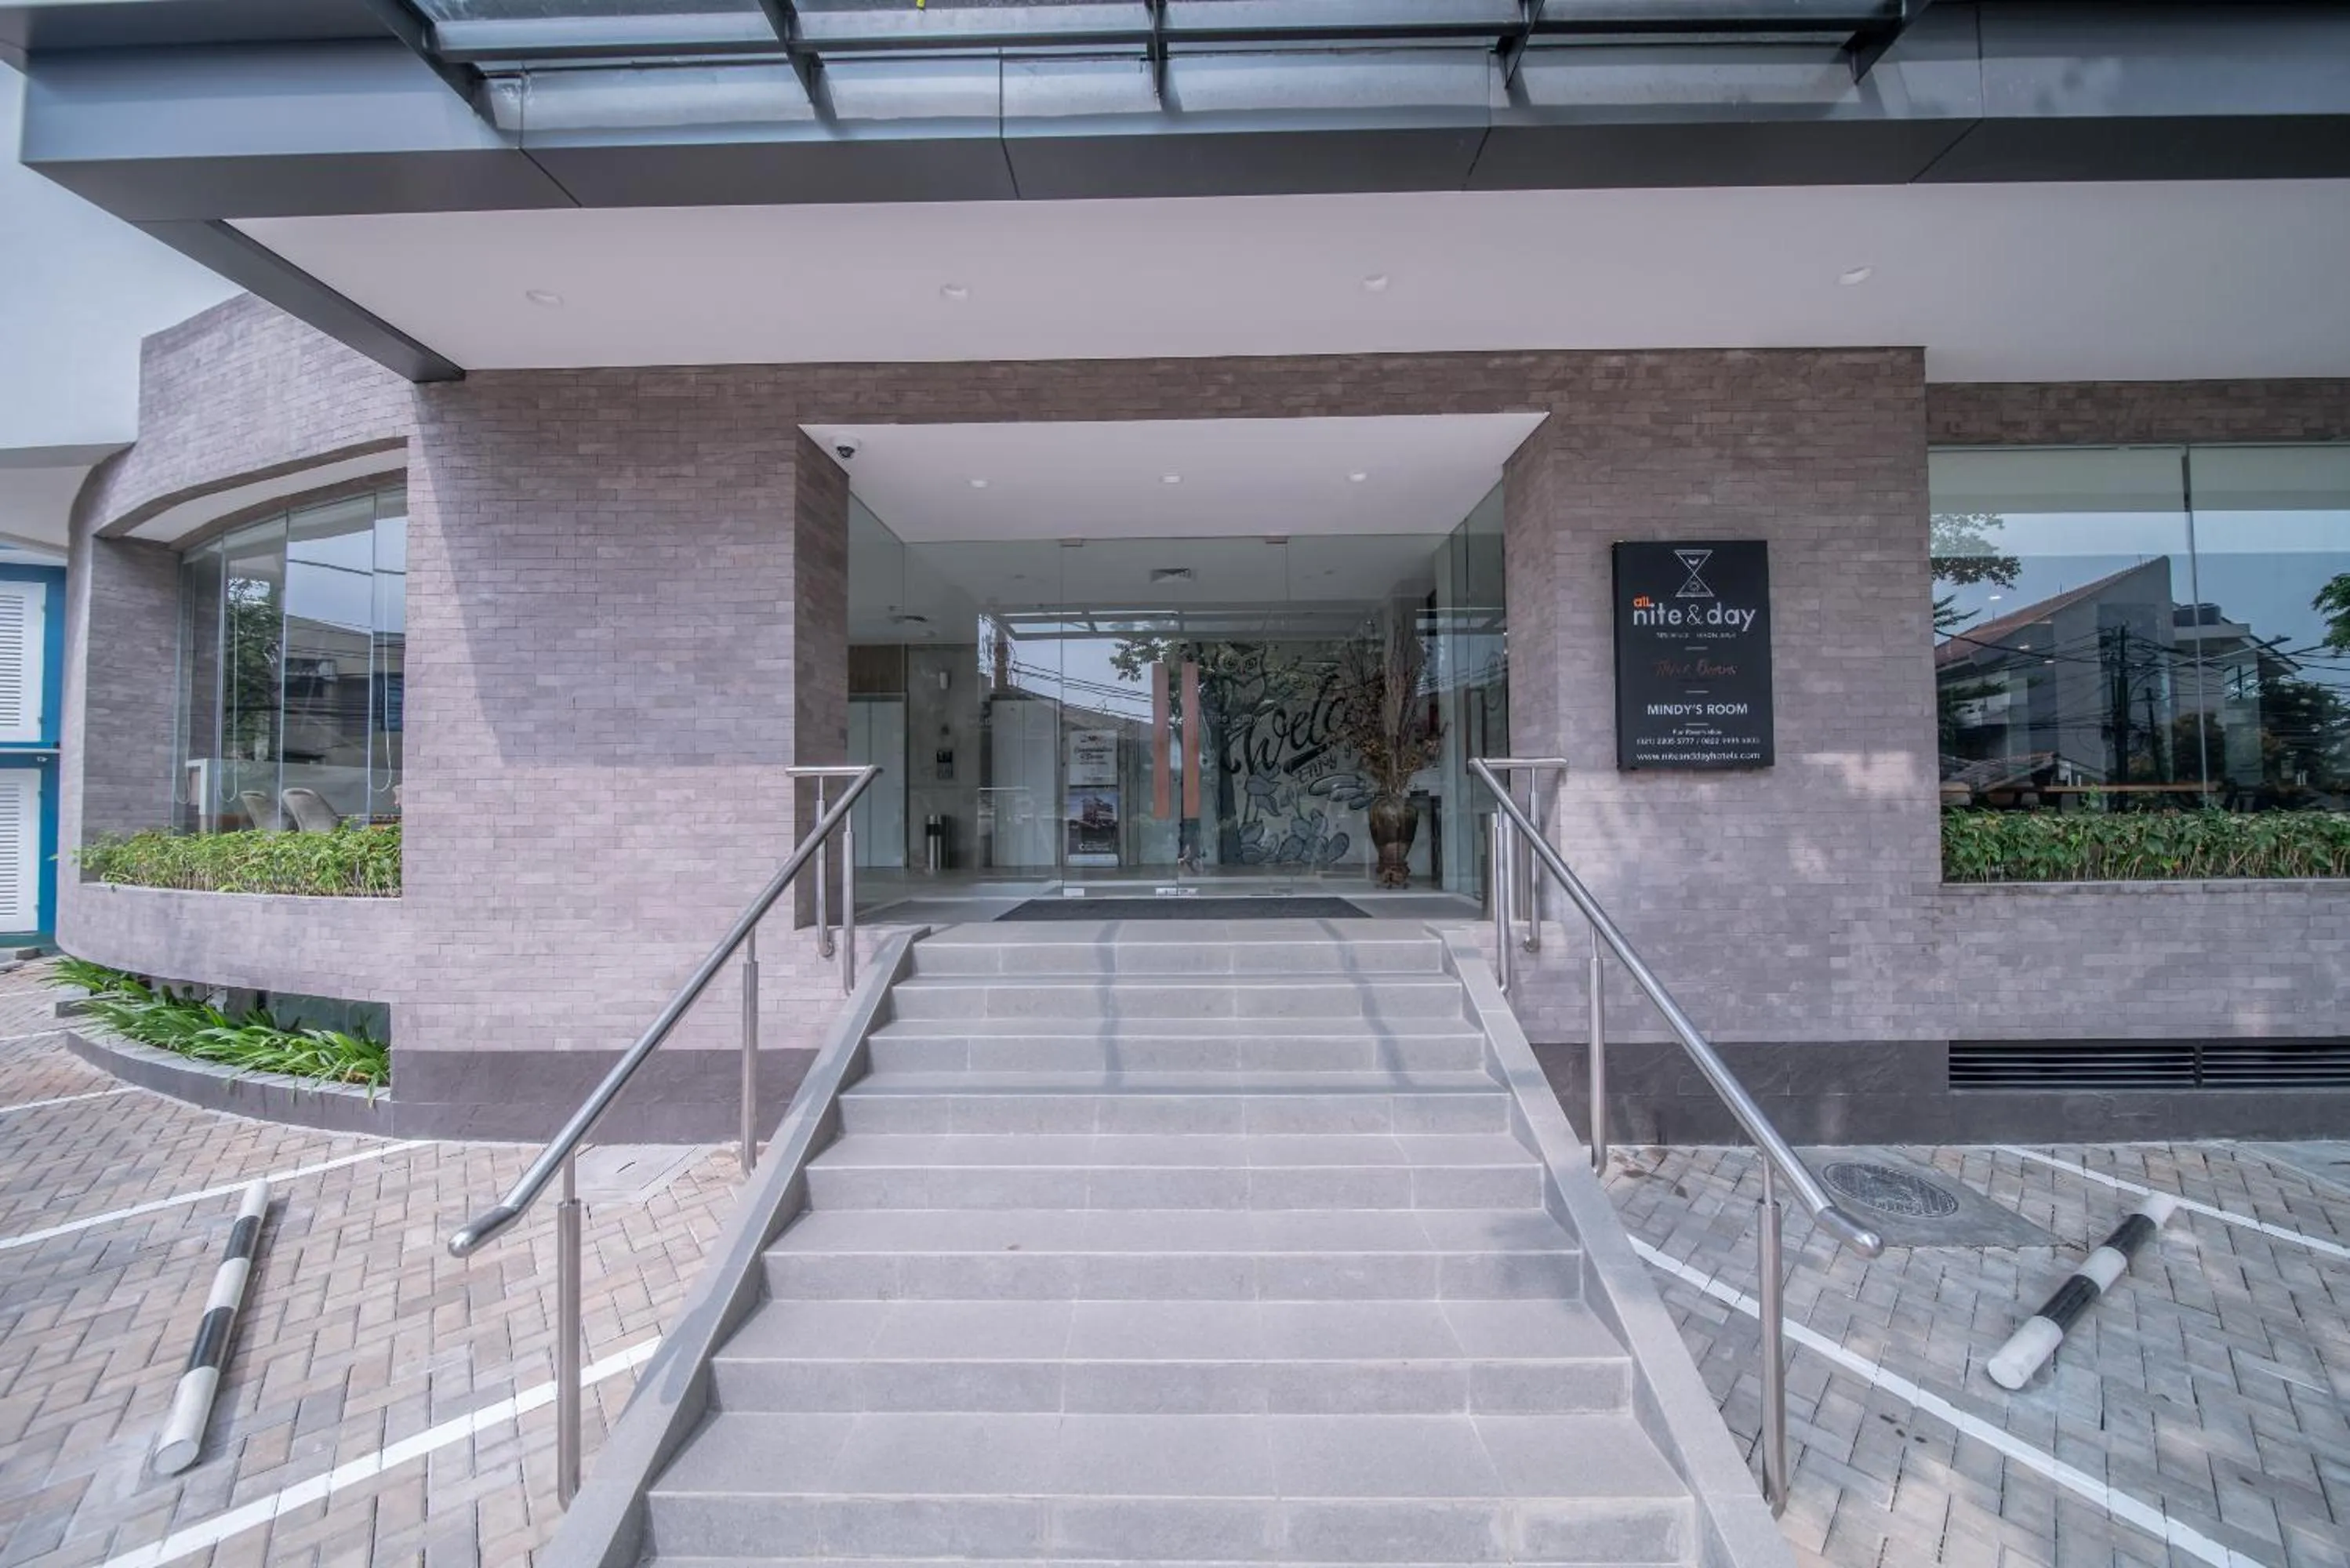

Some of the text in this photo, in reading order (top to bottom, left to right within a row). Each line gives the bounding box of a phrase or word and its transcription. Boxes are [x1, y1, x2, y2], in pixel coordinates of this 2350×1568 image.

[1633, 602, 1756, 632] nite & day
[1647, 704, 1748, 715] MINDY'S ROOM
